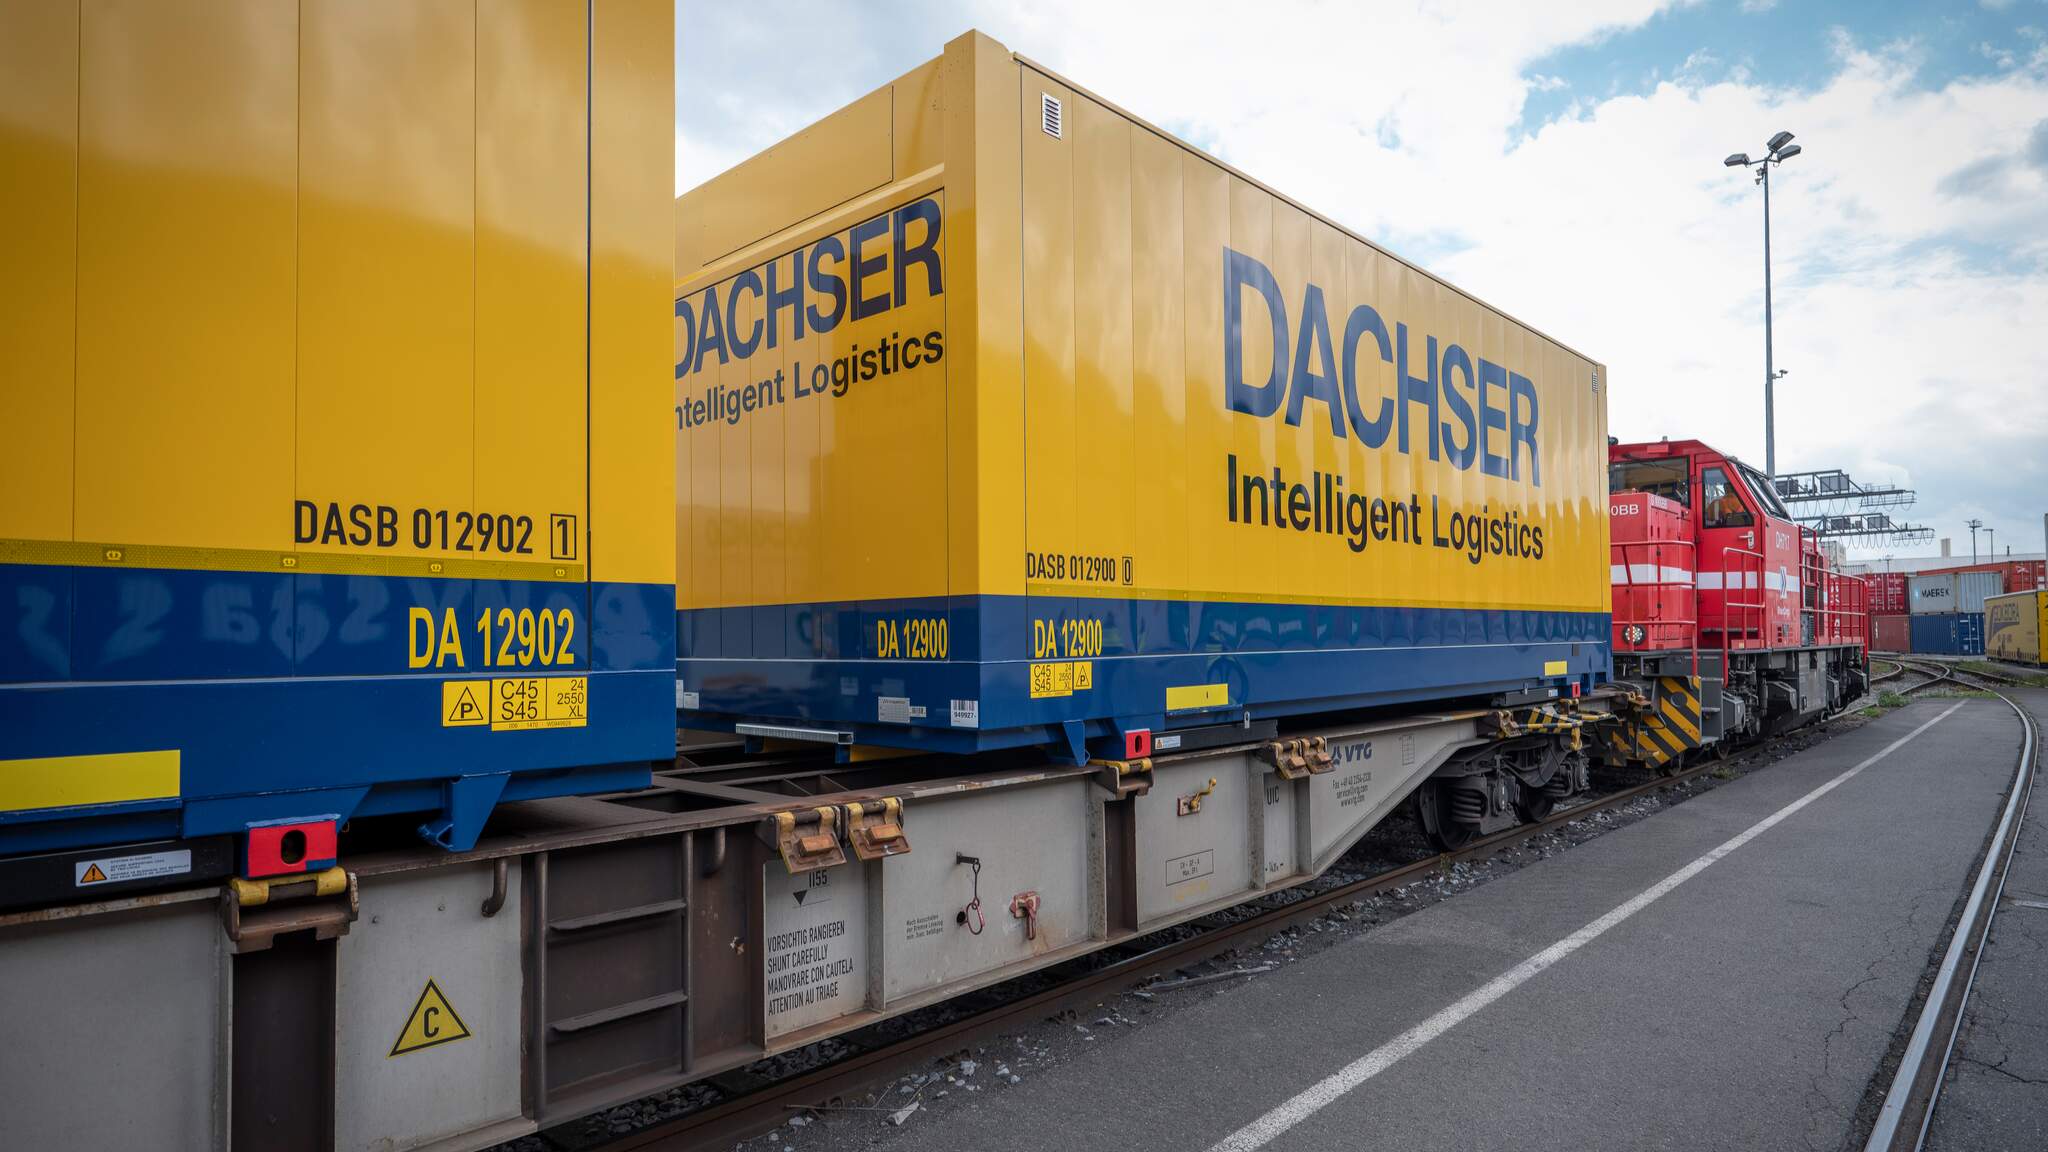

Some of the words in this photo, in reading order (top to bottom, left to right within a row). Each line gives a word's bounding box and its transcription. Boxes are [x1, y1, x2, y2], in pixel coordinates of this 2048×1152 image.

[675, 369, 785, 431] ntelligent
[793, 331, 944, 399] Logistics
[1222, 246, 1541, 488] DACHSER
[1227, 453, 1422, 553] Intelligent
[1432, 494, 1544, 565] Logistics
[294, 500, 398, 546] DASB
[412, 508, 533, 554] 012902
[555, 517, 572, 557] 1
[1026, 551, 1066, 581] DASB
[1069, 554, 1116, 583] 012900
[409, 607, 464, 669] DA
[476, 607, 575, 667] 12902
[877, 619, 899, 658] DA
[903, 618, 948, 658] 12900
[1034, 619, 1058, 659] DA
[1062, 618, 1102, 657] 12900
[570, 679, 584, 691] 24
[1034, 664, 1051, 678] C45
[1034, 678, 1051, 692] S45
[500, 680, 538, 700] C45
[557, 693, 584, 705] 2550
[460, 702, 473, 718] P
[501, 700, 538, 720] S45
[569, 705, 584, 718] XL
[1344, 742, 1373, 763] VTG
[1266, 785, 1280, 805] UIC
[767, 929, 807, 953] VORSICHTIG
[809, 920, 845, 943] RANGIEREN
[767, 953, 790, 974] SHUNT
[792, 944, 828, 968] CAREFULLY
[767, 970, 809, 995] MANOVRARE
[810, 967, 824, 983] CON
[825, 957, 853, 979] CAUTELA
[768, 993, 804, 1016] ATTENTION
[805, 990, 815, 1004] AU
[816, 982, 839, 1000] TRIAGE
[424, 1006, 440, 1039] C
